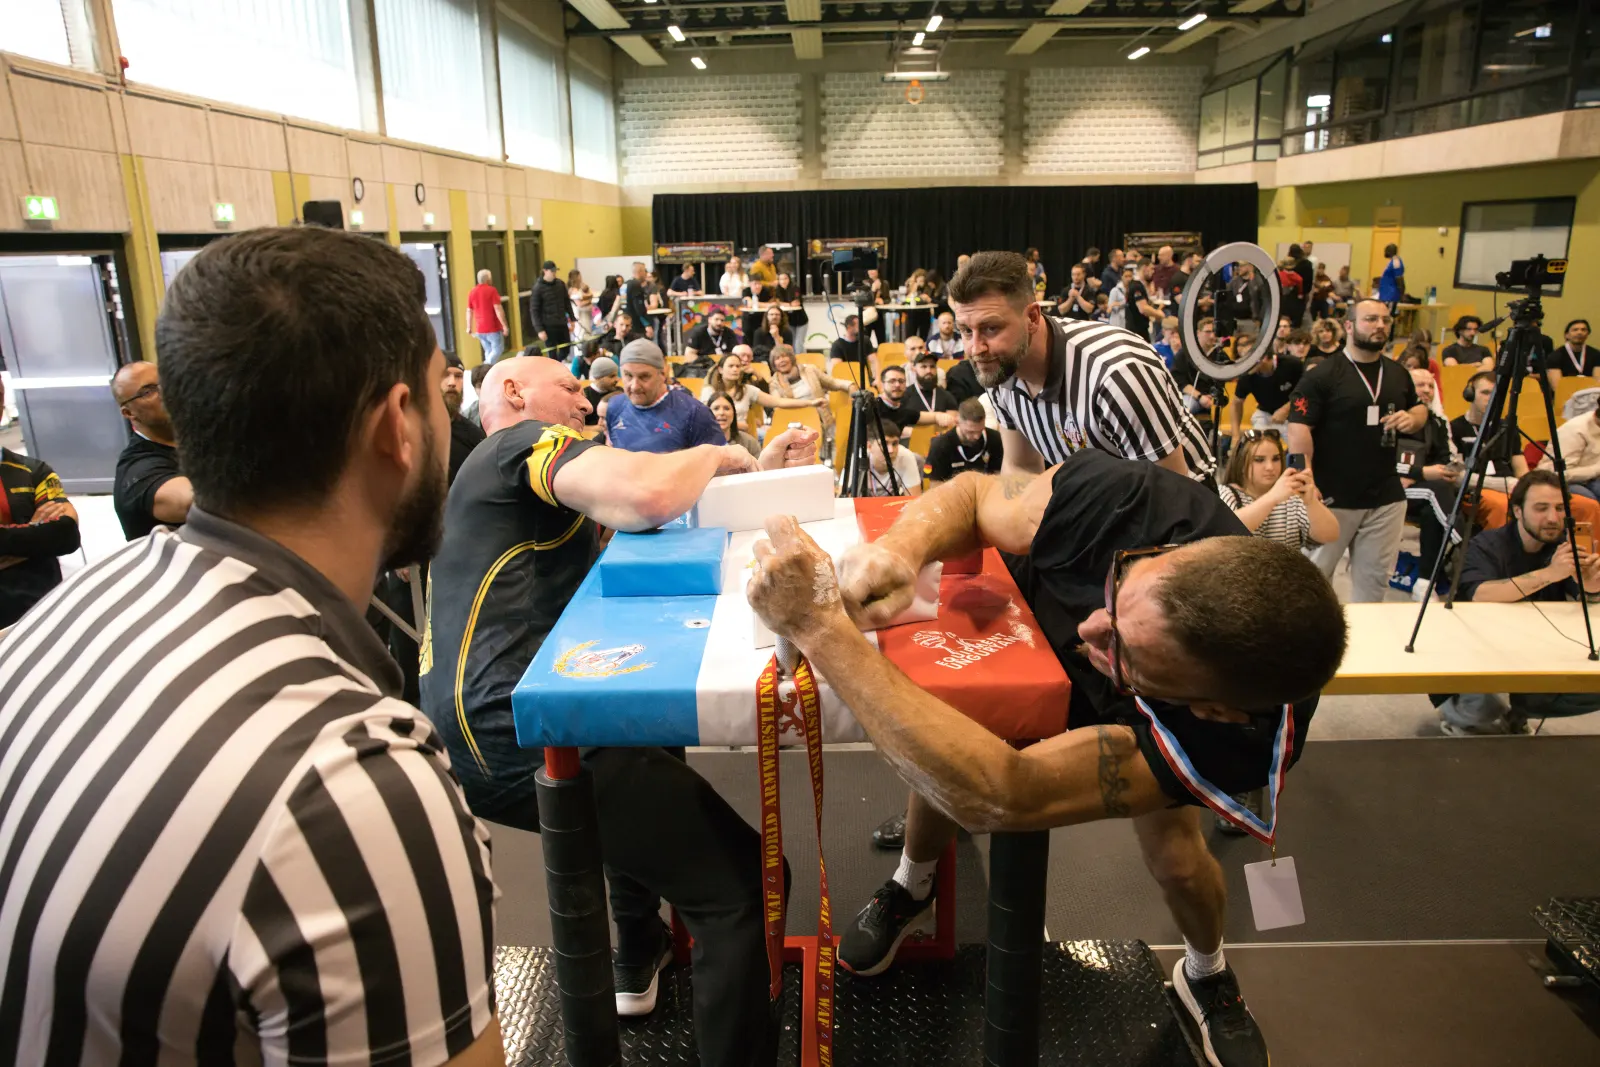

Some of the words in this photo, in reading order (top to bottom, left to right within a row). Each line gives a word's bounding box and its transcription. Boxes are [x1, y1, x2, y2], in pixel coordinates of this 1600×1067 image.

[935, 632, 1007, 666] EQUIPMENT
[946, 635, 1020, 670] UNGURYAN
[760, 672, 777, 807] ARMWRESTLING
[766, 812, 779, 868] WORLD
[768, 890, 781, 922] WAF
[820, 896, 830, 929] WAF
[819, 947, 832, 978] WAF
[817, 998, 830, 1028] WAF
